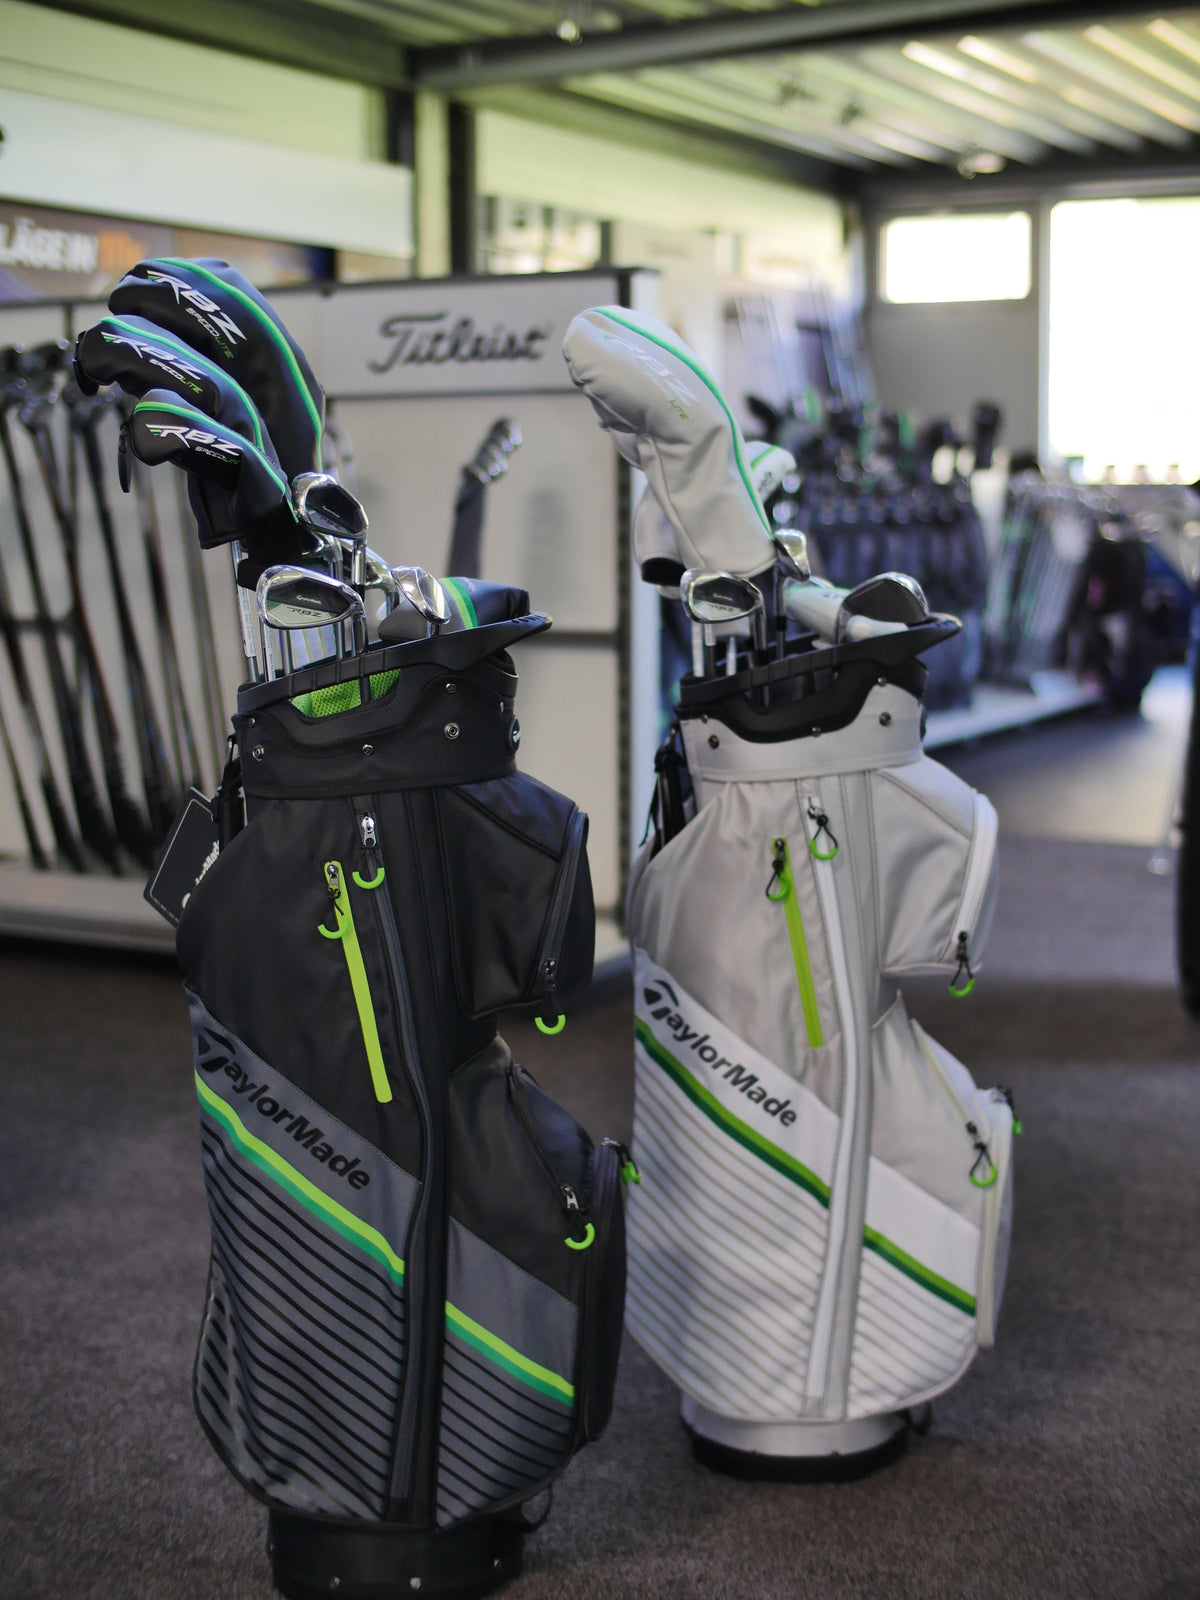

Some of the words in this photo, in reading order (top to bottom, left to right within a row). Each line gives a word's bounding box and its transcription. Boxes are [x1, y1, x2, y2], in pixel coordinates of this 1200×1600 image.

[146, 269, 248, 345] RBZ
[185, 307, 235, 360] SPEEDLITE
[100, 331, 209, 381] RBZ
[367, 310, 549, 374] Titleist
[149, 358, 203, 395] SPEEDLITE
[145, 423, 244, 457] RBZ
[287, 606, 323, 618] RBZ
[643, 979, 797, 1127] TaylorMade
[198, 1026, 371, 1191] TaylorMade
